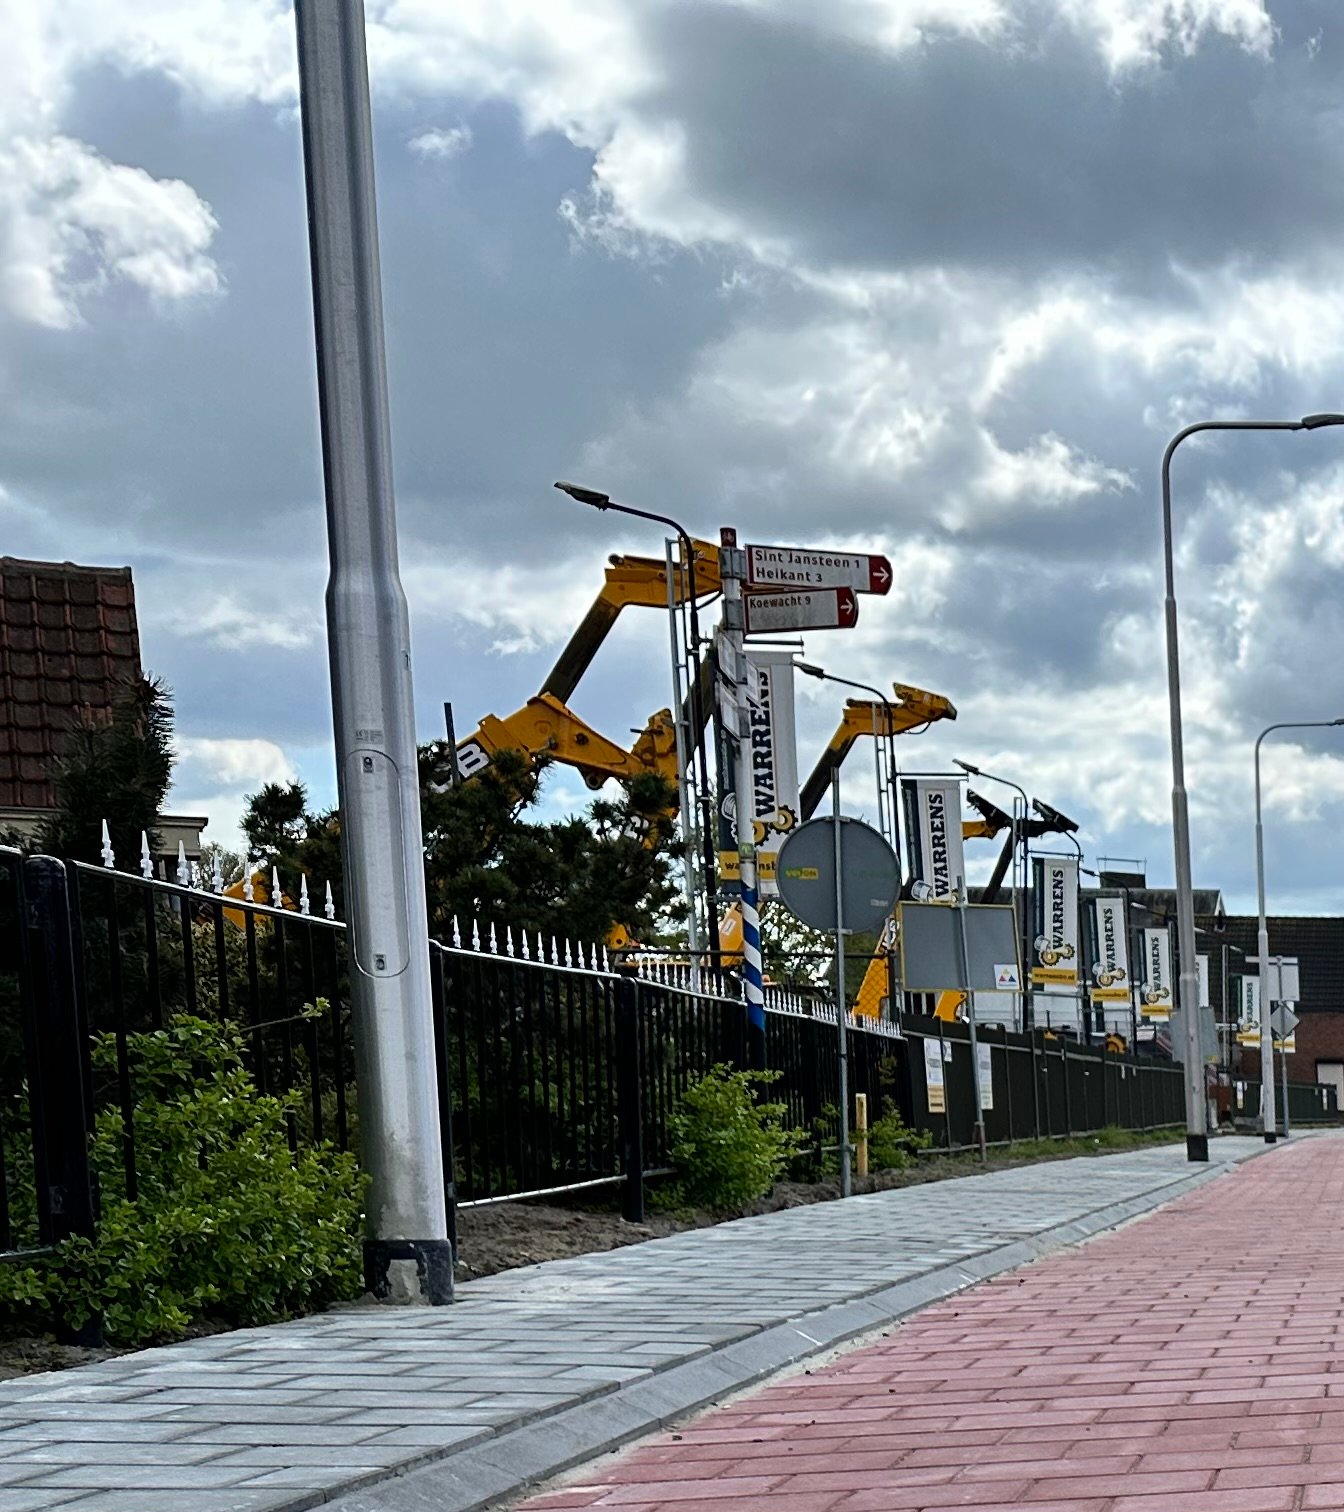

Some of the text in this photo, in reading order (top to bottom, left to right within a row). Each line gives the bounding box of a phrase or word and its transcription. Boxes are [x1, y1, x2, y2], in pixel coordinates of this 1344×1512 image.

[755, 550, 860, 569] Sint Jansteen 1
[756, 567, 823, 583] Heikant 3
[750, 595, 811, 609] Koewacht 9
[928, 793, 949, 898] WARRENS
[1052, 869, 1064, 950] WARRENS
[1103, 908, 1116, 973] WARRENS
